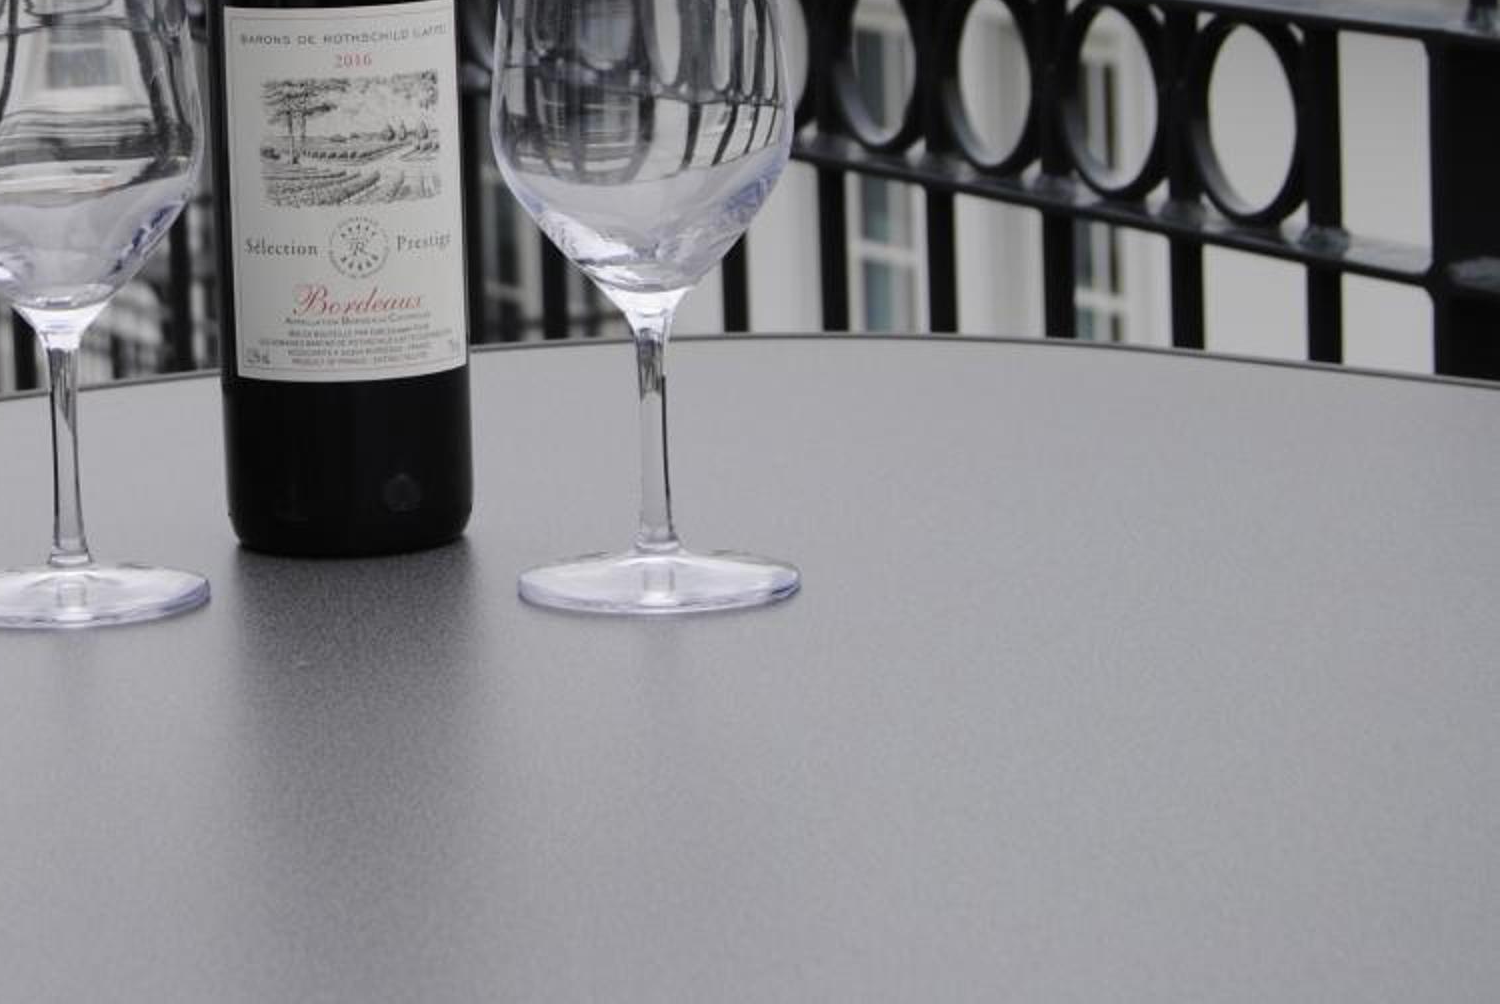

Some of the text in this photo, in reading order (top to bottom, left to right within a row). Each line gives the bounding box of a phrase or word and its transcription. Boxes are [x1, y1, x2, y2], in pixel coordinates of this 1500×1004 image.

[240, 34, 291, 46] BARONS
[298, 34, 318, 45] DE
[323, 30, 408, 45] ROTHSCHILD
[335, 53, 373, 69] 2016
[292, 283, 422, 316] Bordeaux
